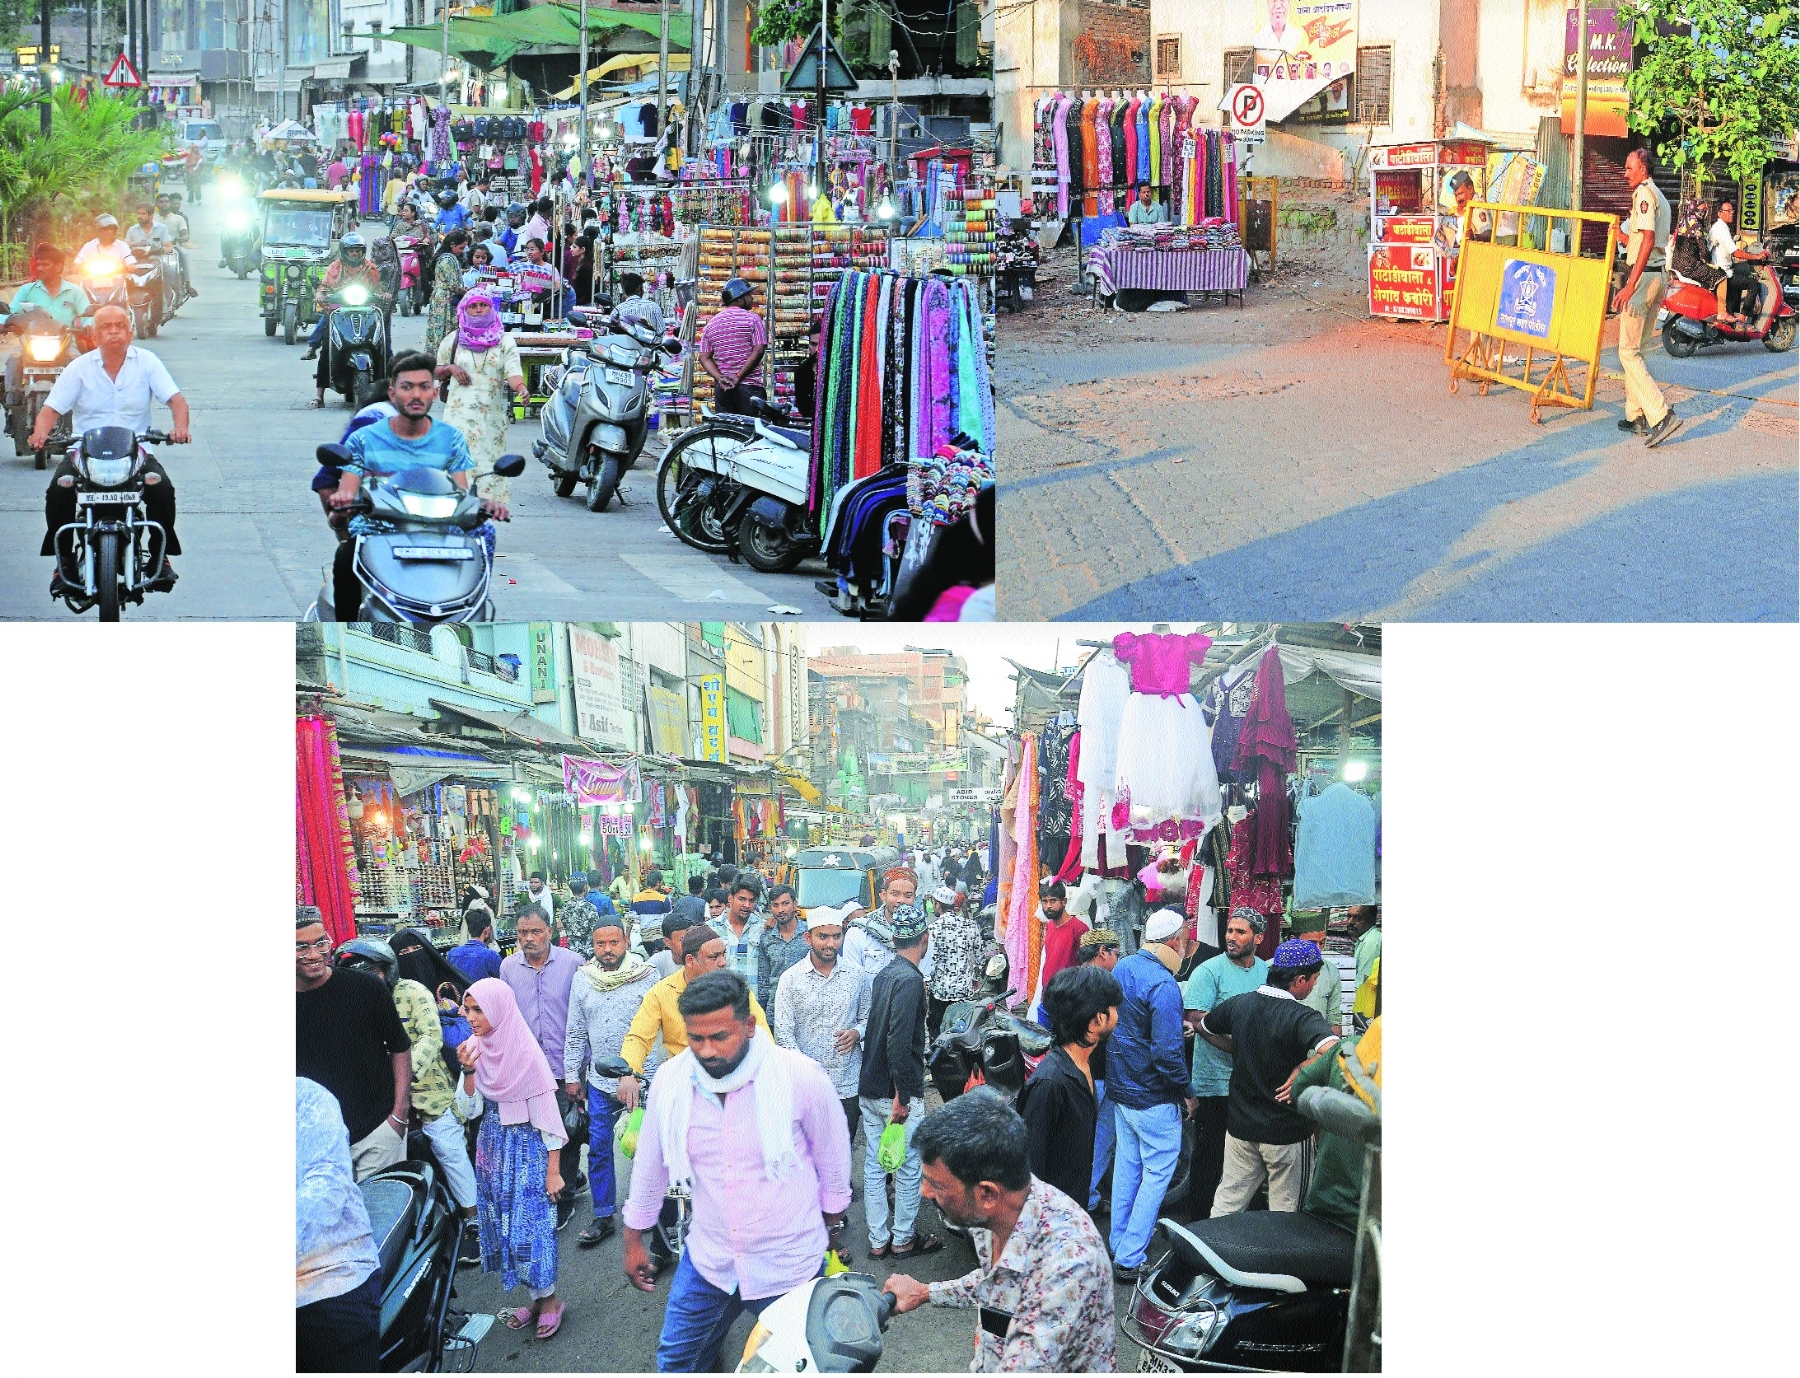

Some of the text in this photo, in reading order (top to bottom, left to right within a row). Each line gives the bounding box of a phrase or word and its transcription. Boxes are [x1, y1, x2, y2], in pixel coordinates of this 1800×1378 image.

[1567, 52, 1628, 73] Clection
[1244, 95, 1257, 119] P
[536, 632, 548, 689] UNANI
[602, 817, 618, 825] SALE
[1161, 1280, 1181, 1298] SUZUKI
